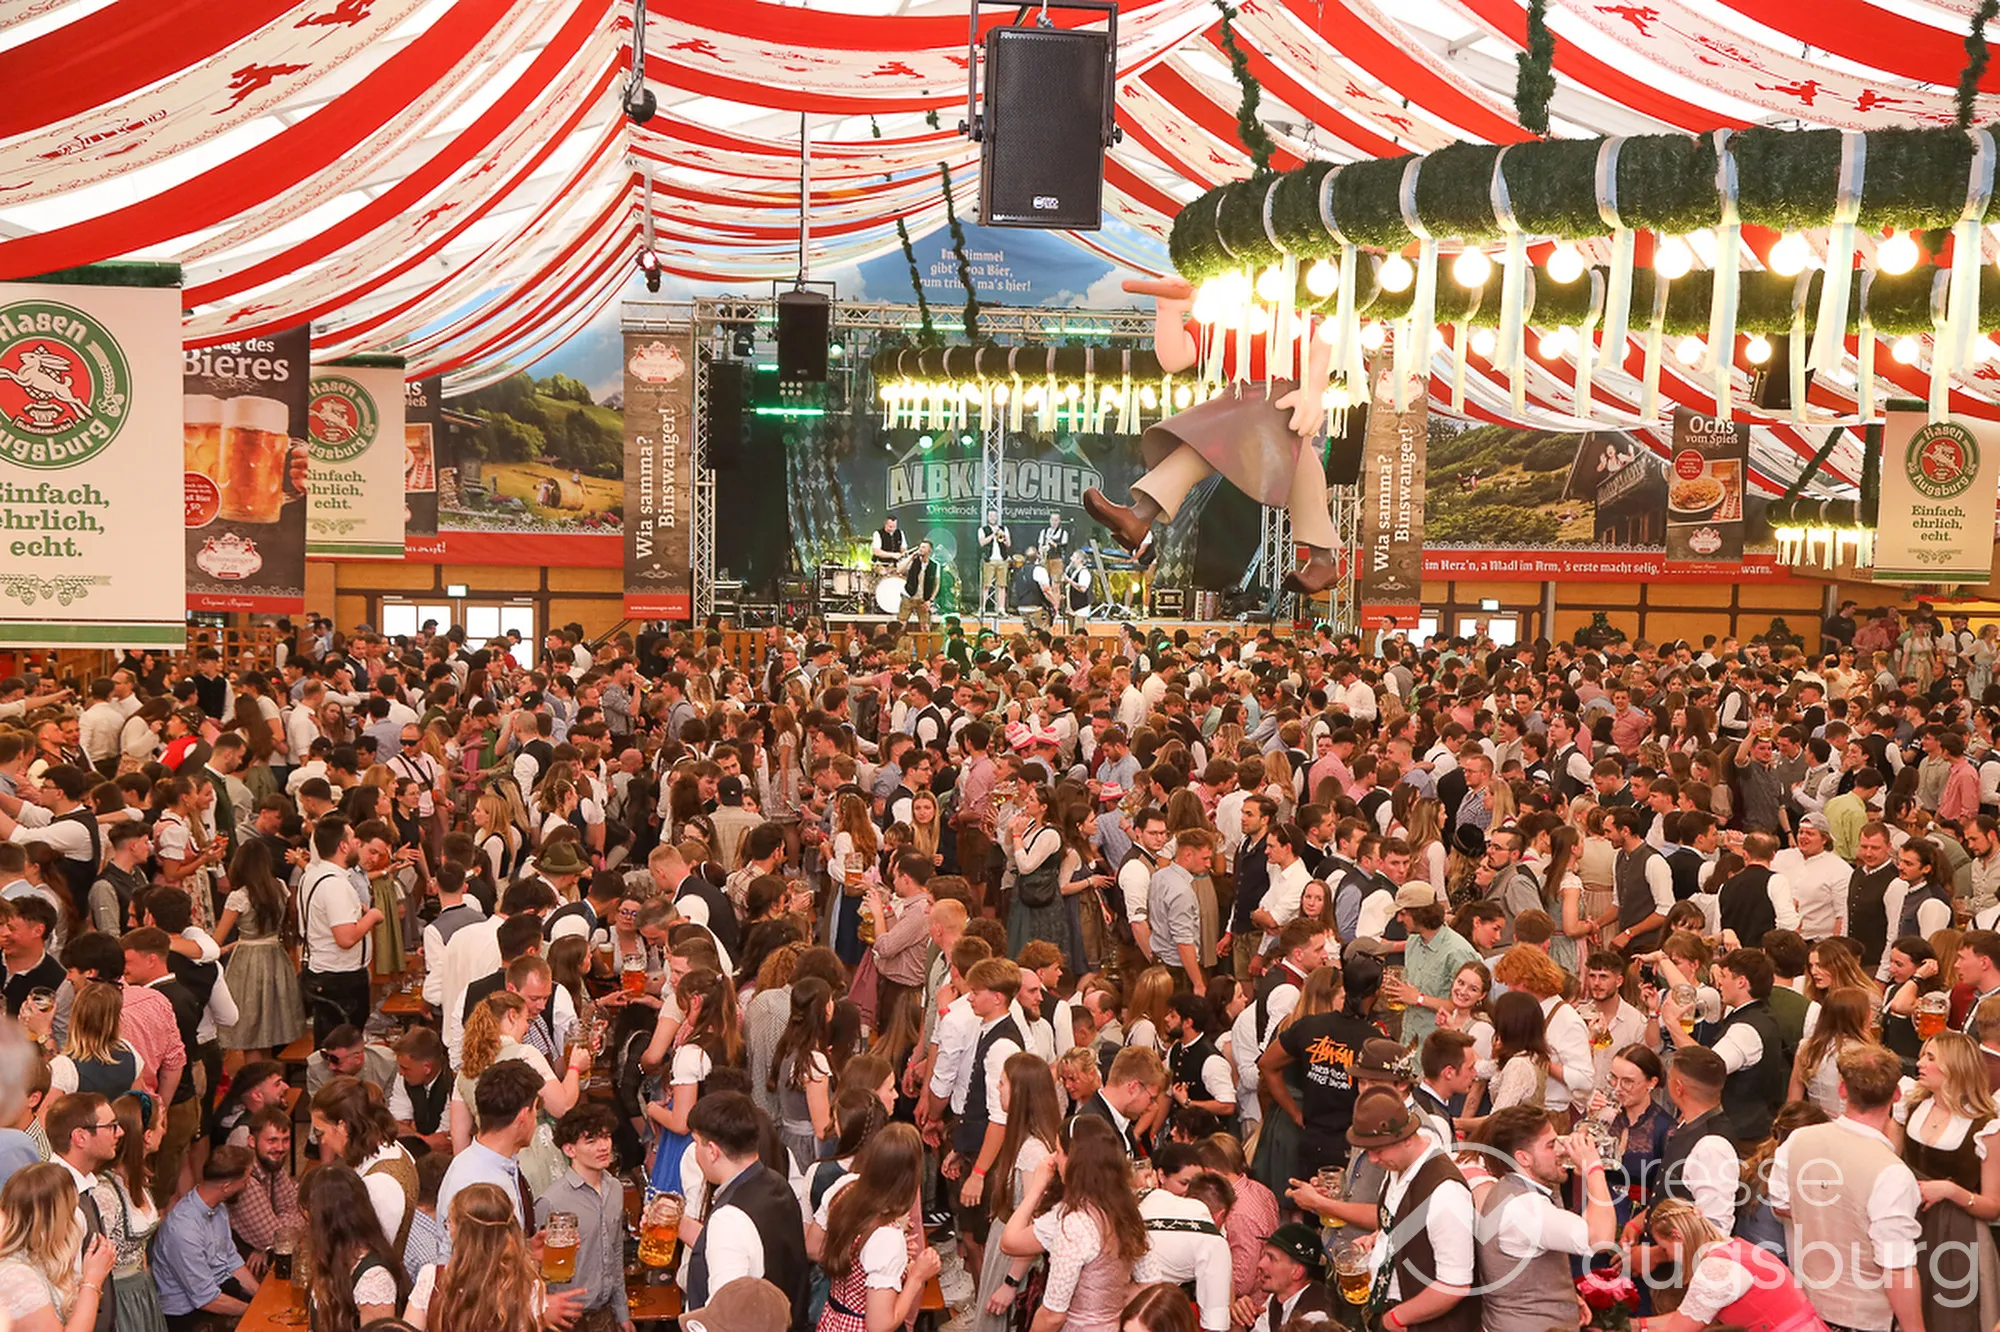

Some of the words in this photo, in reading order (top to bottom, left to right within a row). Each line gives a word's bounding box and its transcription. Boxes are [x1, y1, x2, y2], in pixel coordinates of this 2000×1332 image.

[987, 265, 1013, 278] Bier,
[1005, 279, 1032, 293] hier!
[245, 338, 276, 353] des
[183, 347, 290, 382] Bieres
[1689, 415, 1735, 434] Ochs
[1923, 426, 1964, 441] Hasen
[0, 417, 112, 461] ugsburg
[308, 438, 368, 460] ugsburg
[1684, 435, 1708, 443] vom
[1709, 432, 1739, 446] Spieß
[636, 435, 654, 514] samma?
[658, 408, 680, 528] Binswanger!
[0, 482, 110, 509] infach,
[1377, 454, 1393, 530] samma?
[1395, 428, 1417, 542] Binswanger!
[1912, 474, 1969, 496] Augsburg
[314, 497, 352, 509] echt.
[1912, 505, 1966, 518] Einfach,
[0, 508, 105, 535] hrlich,
[1912, 518, 1963, 530] ehrlich,
[9, 535, 83, 557] echt.
[635, 519, 654, 560] Wia
[1920, 530, 1952, 541] echt.
[1374, 534, 1390, 572] Wia
[1425, 559, 1439, 570] im
[1481, 562, 1488, 570] a
[1490, 560, 1518, 571] Madl
[1519, 560, 1533, 571] im
[1573, 563, 1599, 572] erste
[1600, 562, 1631, 574] macht
[1741, 565, 1773, 574] warm.
